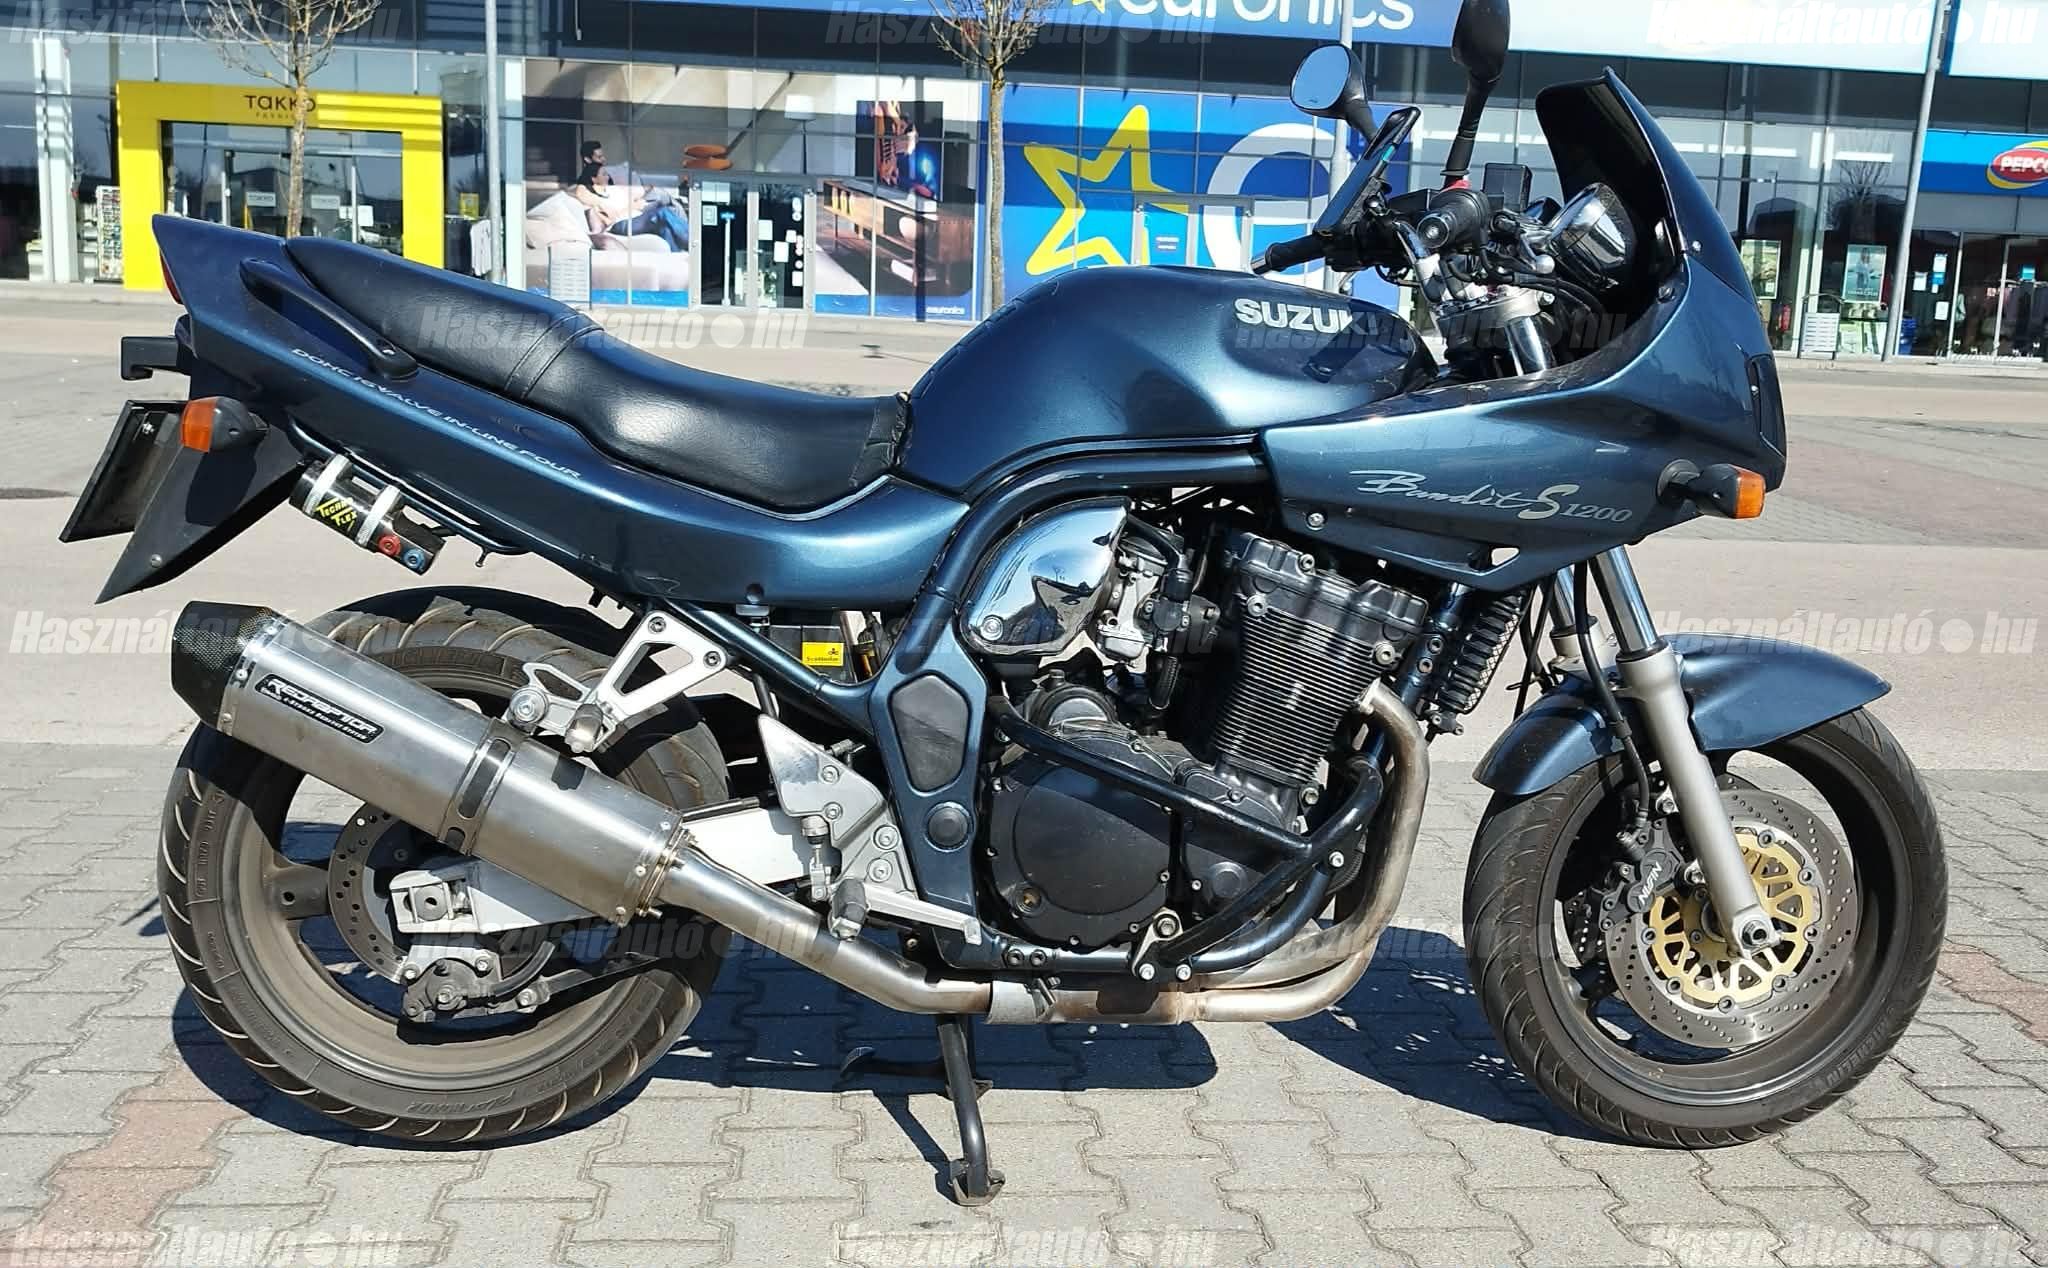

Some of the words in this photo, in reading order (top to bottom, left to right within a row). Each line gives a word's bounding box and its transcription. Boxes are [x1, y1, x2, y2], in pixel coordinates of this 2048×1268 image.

[2000, 155, 2048, 174] PEPC
[1233, 298, 1379, 336] SUZUKI
[291, 348, 354, 377] DOHC
[519, 449, 582, 479] FOUR
[1349, 470, 1538, 510] Bandit
[1638, 861, 1663, 905] NISSIN
